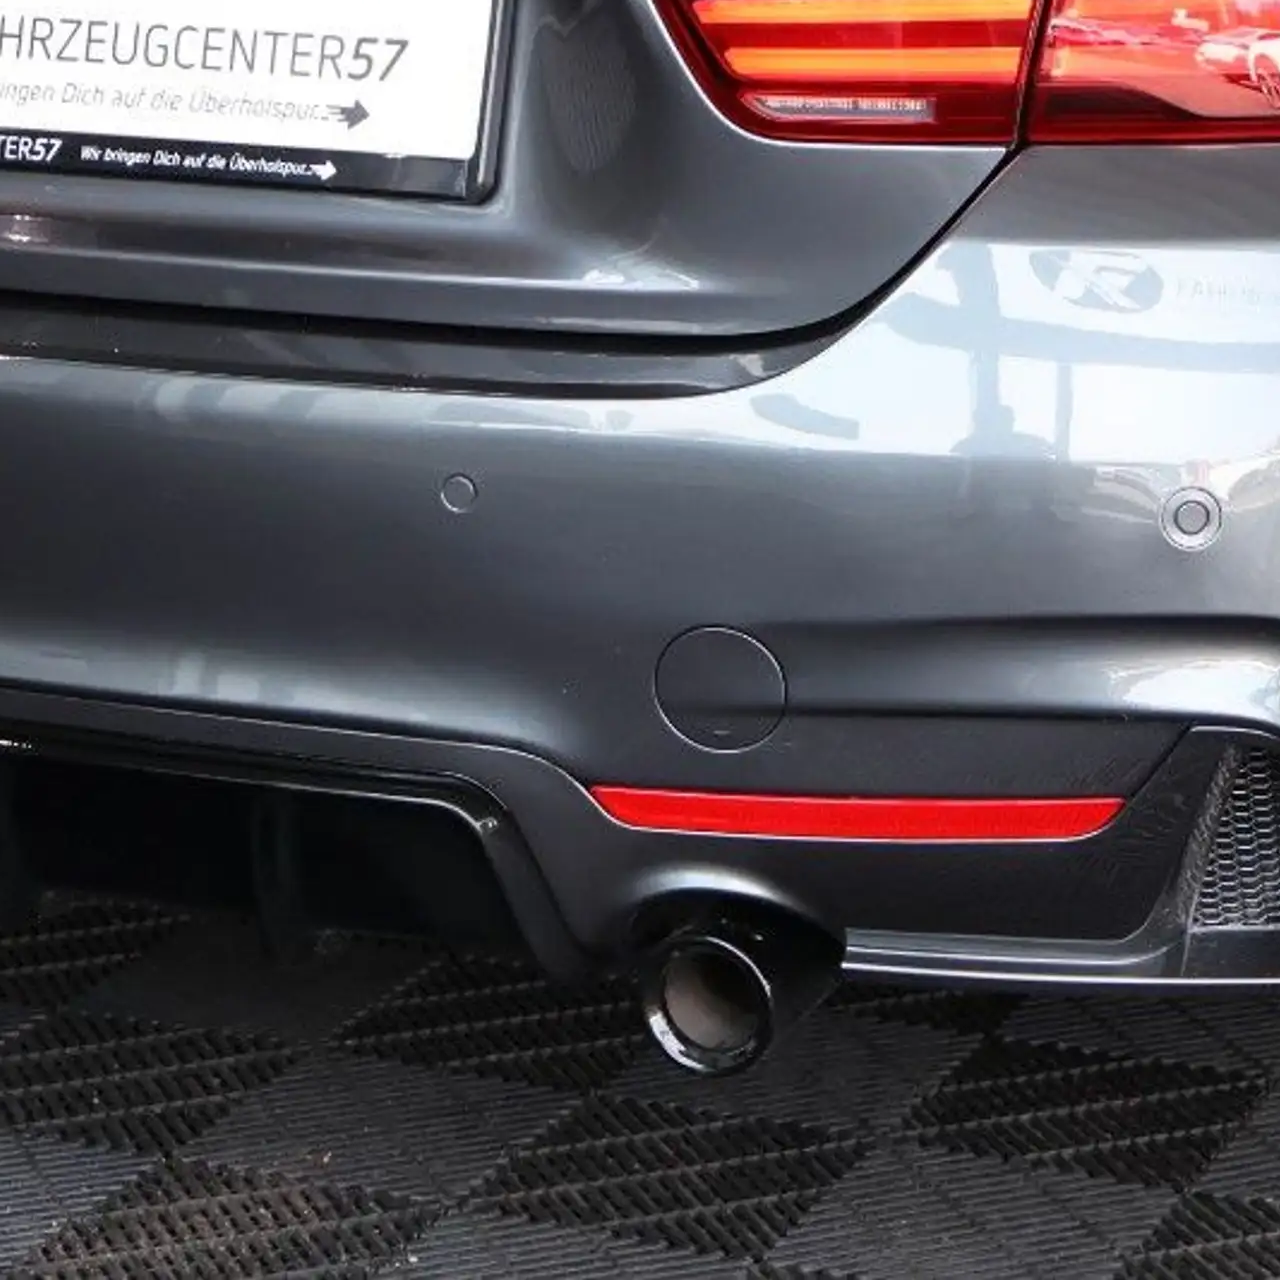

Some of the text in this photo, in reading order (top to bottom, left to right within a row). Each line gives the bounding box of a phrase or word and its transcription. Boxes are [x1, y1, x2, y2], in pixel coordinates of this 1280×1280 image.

[61, 81, 106, 105] Dich
[111, 86, 147, 109] auf
[150, 88, 183, 112] die
[80, 145, 102, 160] Wir
[103, 147, 151, 166] bringen
[152, 149, 181, 166] Dich
[182, 152, 206, 168] auf
[206, 153, 227, 170] die
